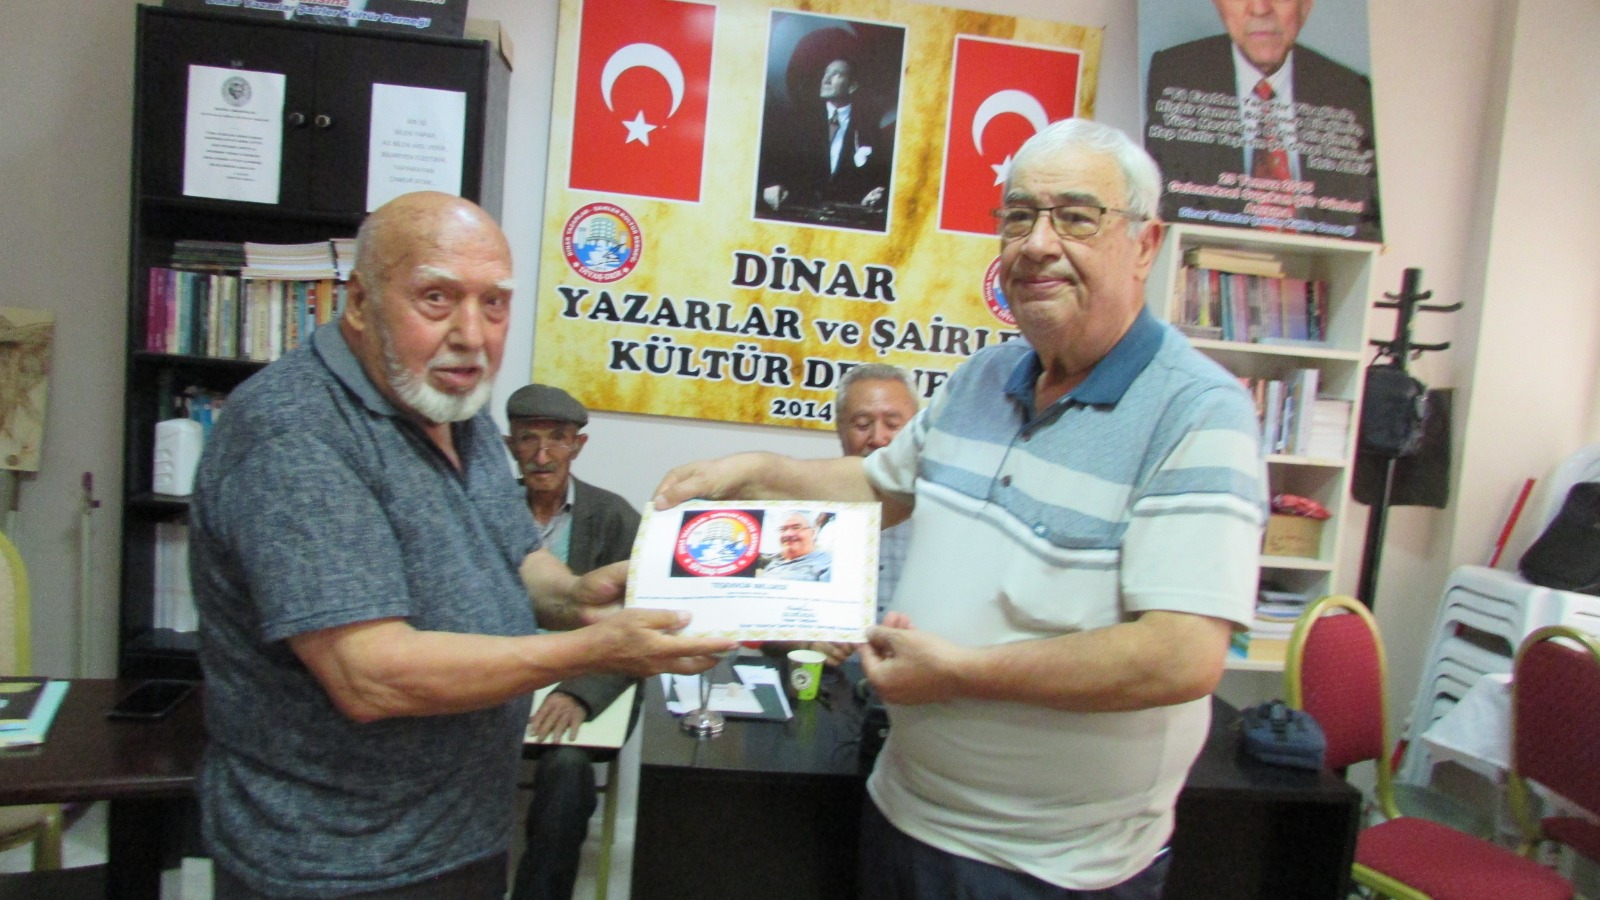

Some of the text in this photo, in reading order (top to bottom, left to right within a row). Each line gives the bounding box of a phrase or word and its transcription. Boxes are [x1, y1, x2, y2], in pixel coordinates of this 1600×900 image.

[340, 8, 380, 21] Kültür
[381, 13, 432, 29] Derneği
[731, 247, 895, 301] DİNAR
[558, 287, 801, 340] YAZARLAR
[815, 320, 859, 344] ve
[609, 336, 791, 385] KÜLTÜR
[772, 400, 832, 421] 2014
